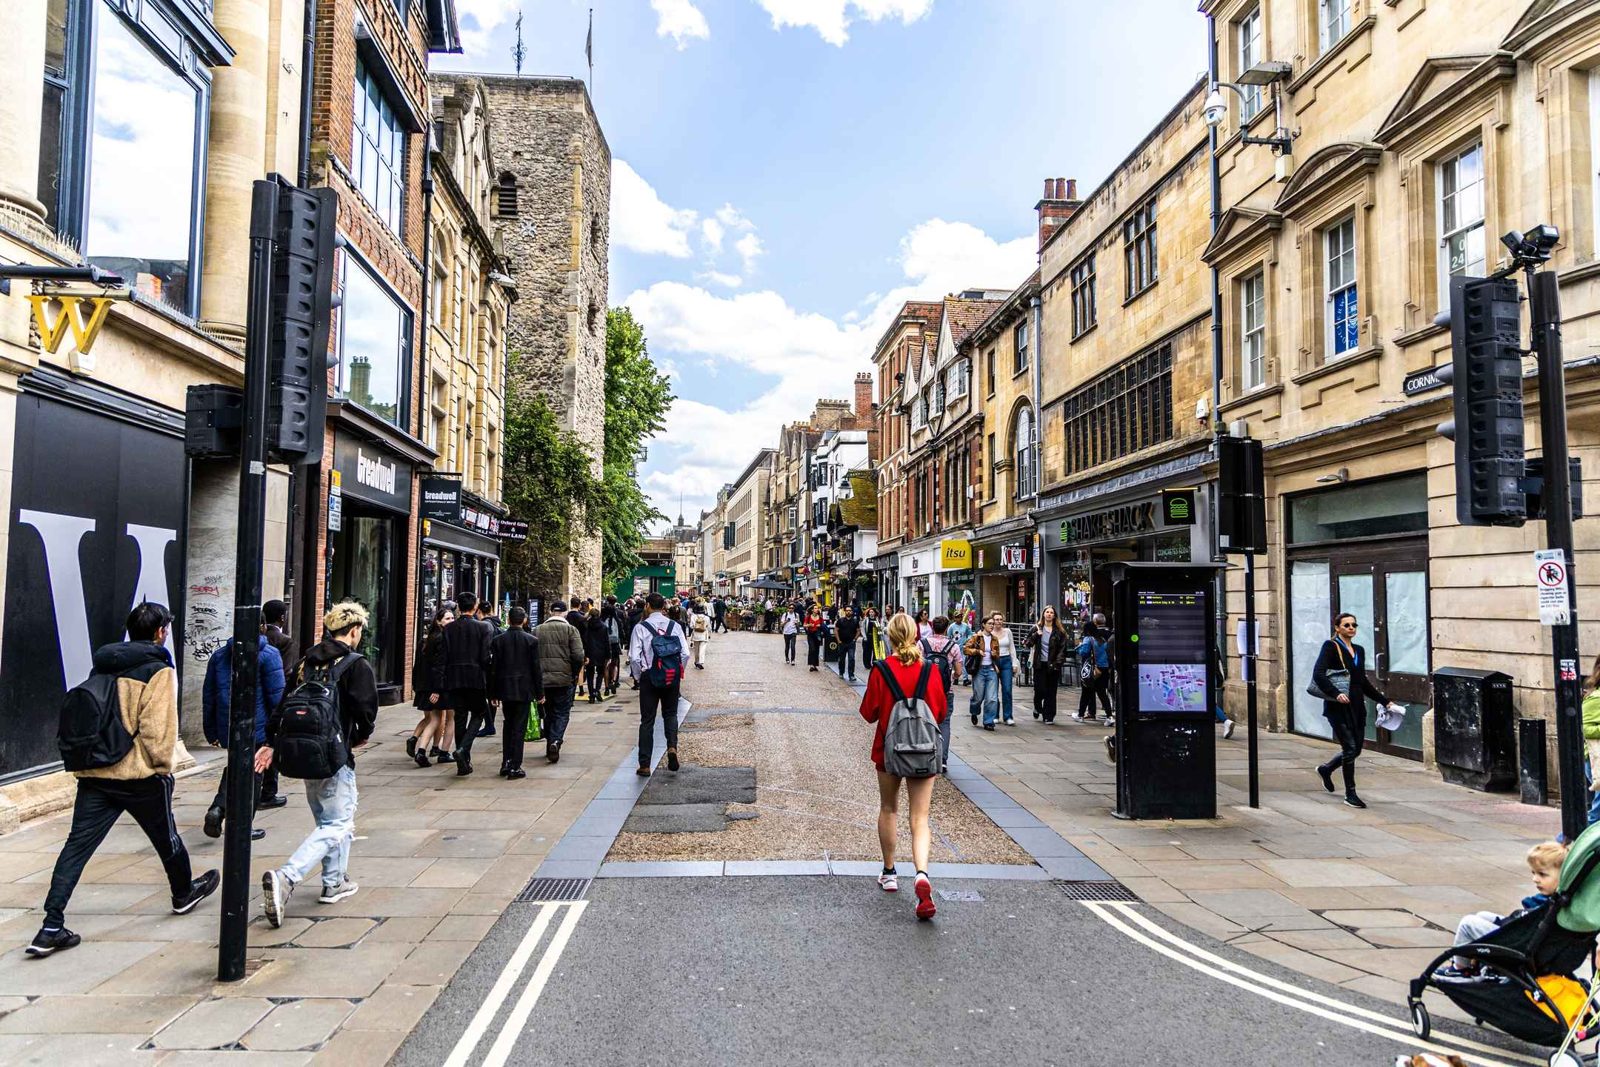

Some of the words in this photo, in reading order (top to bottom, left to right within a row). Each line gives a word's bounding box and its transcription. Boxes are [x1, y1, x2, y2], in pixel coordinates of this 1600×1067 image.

[24, 295, 117, 355] W
[1407, 374, 1440, 391] CORNM
[946, 547, 966, 558] itsu
